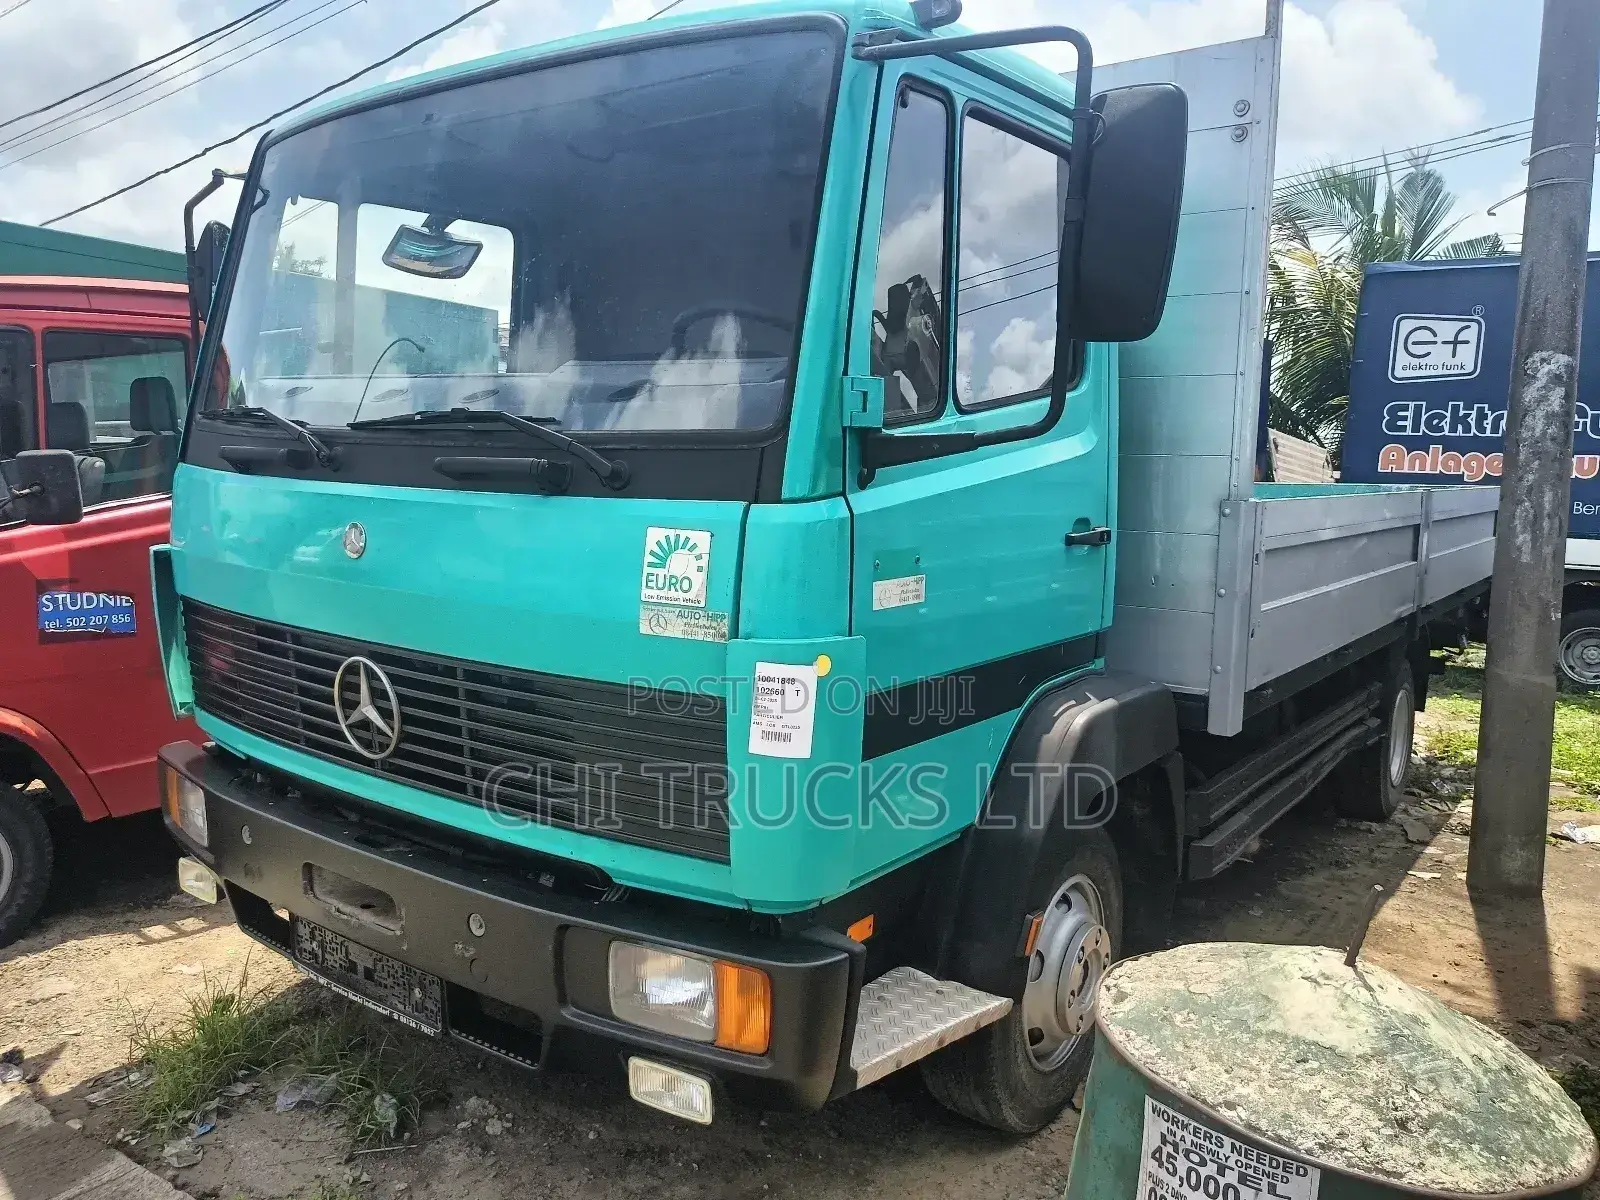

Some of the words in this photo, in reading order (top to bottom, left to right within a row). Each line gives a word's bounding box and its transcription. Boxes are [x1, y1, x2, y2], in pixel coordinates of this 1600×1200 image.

[1401, 361, 1439, 372] elektro
[1441, 361, 1467, 372] funk
[1381, 401, 1508, 437] Elektr
[1378, 443, 1504, 482] Anlage
[645, 572, 693, 594] EURO
[644, 592, 655, 600] Low
[656, 594, 681, 603] Emission
[682, 596, 702, 605] Vehicle
[44, 618, 63, 629] tel.
[66, 616, 87, 628] 502
[89, 614, 109, 626] 207
[111, 613, 131, 624] 856
[795, 689, 801, 697] T
[1151, 1102, 1225, 1149] WORKERS
[1231, 1141, 1309, 1178] NEEDED
[1160, 1132, 1292, 1200] HOTEL
[1166, 1126, 1177, 1139] IN
[1179, 1135, 1187, 1145] A
[1190, 1140, 1232, 1164] NEWLY
[1235, 1158, 1290, 1185] OPENED
[1148, 1171, 1166, 1190] PLUS
[1166, 1183, 1170, 1194] 2
